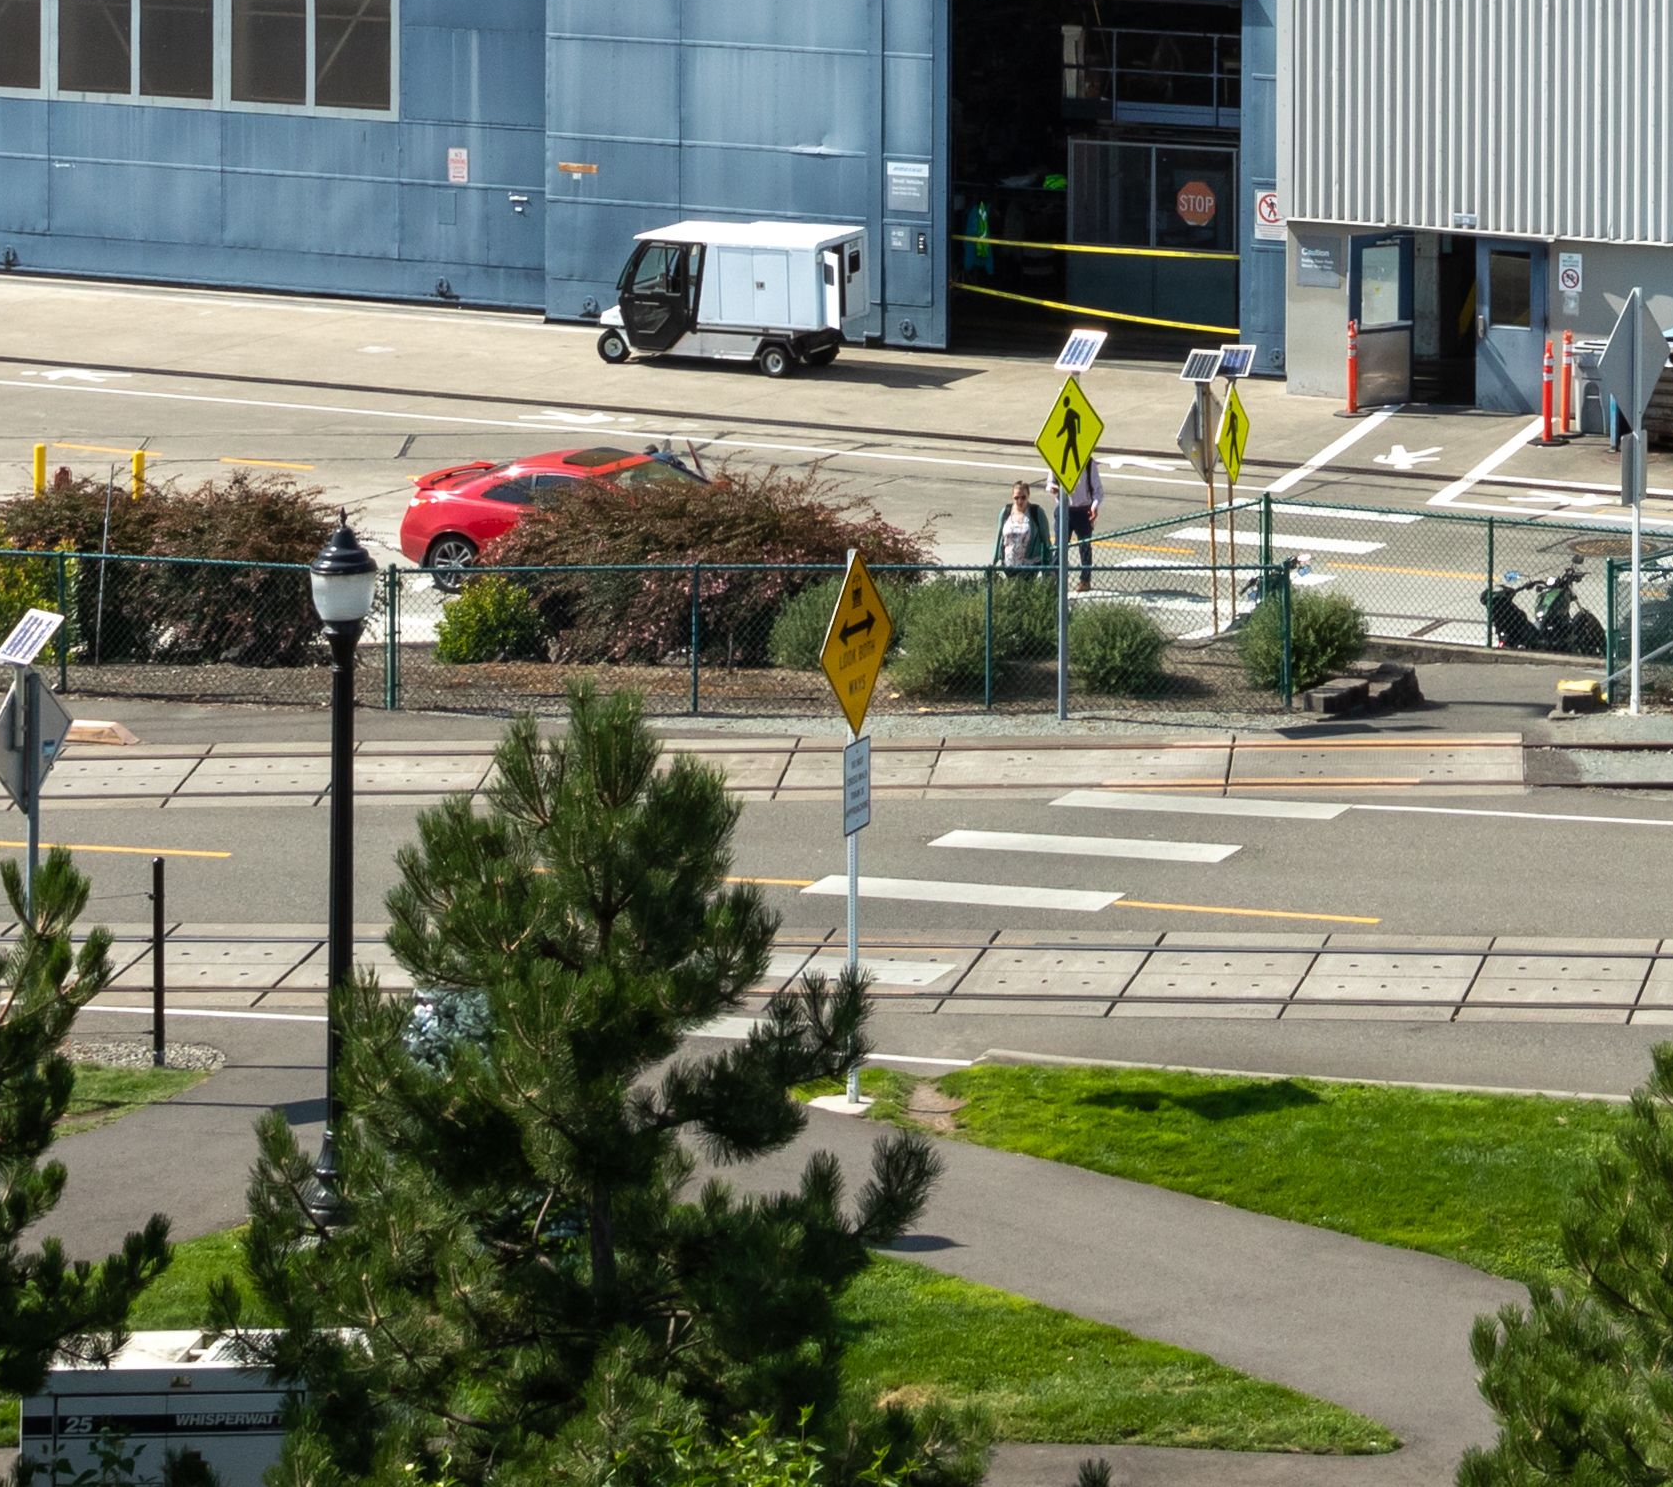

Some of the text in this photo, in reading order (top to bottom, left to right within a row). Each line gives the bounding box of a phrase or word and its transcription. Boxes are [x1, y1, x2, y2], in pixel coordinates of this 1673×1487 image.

[1179, 194, 1214, 213] STOP
[839, 639, 876, 670] LOOK BOTH
[849, 674, 867, 696] WAYS
[65, 1415, 94, 1434] 25
